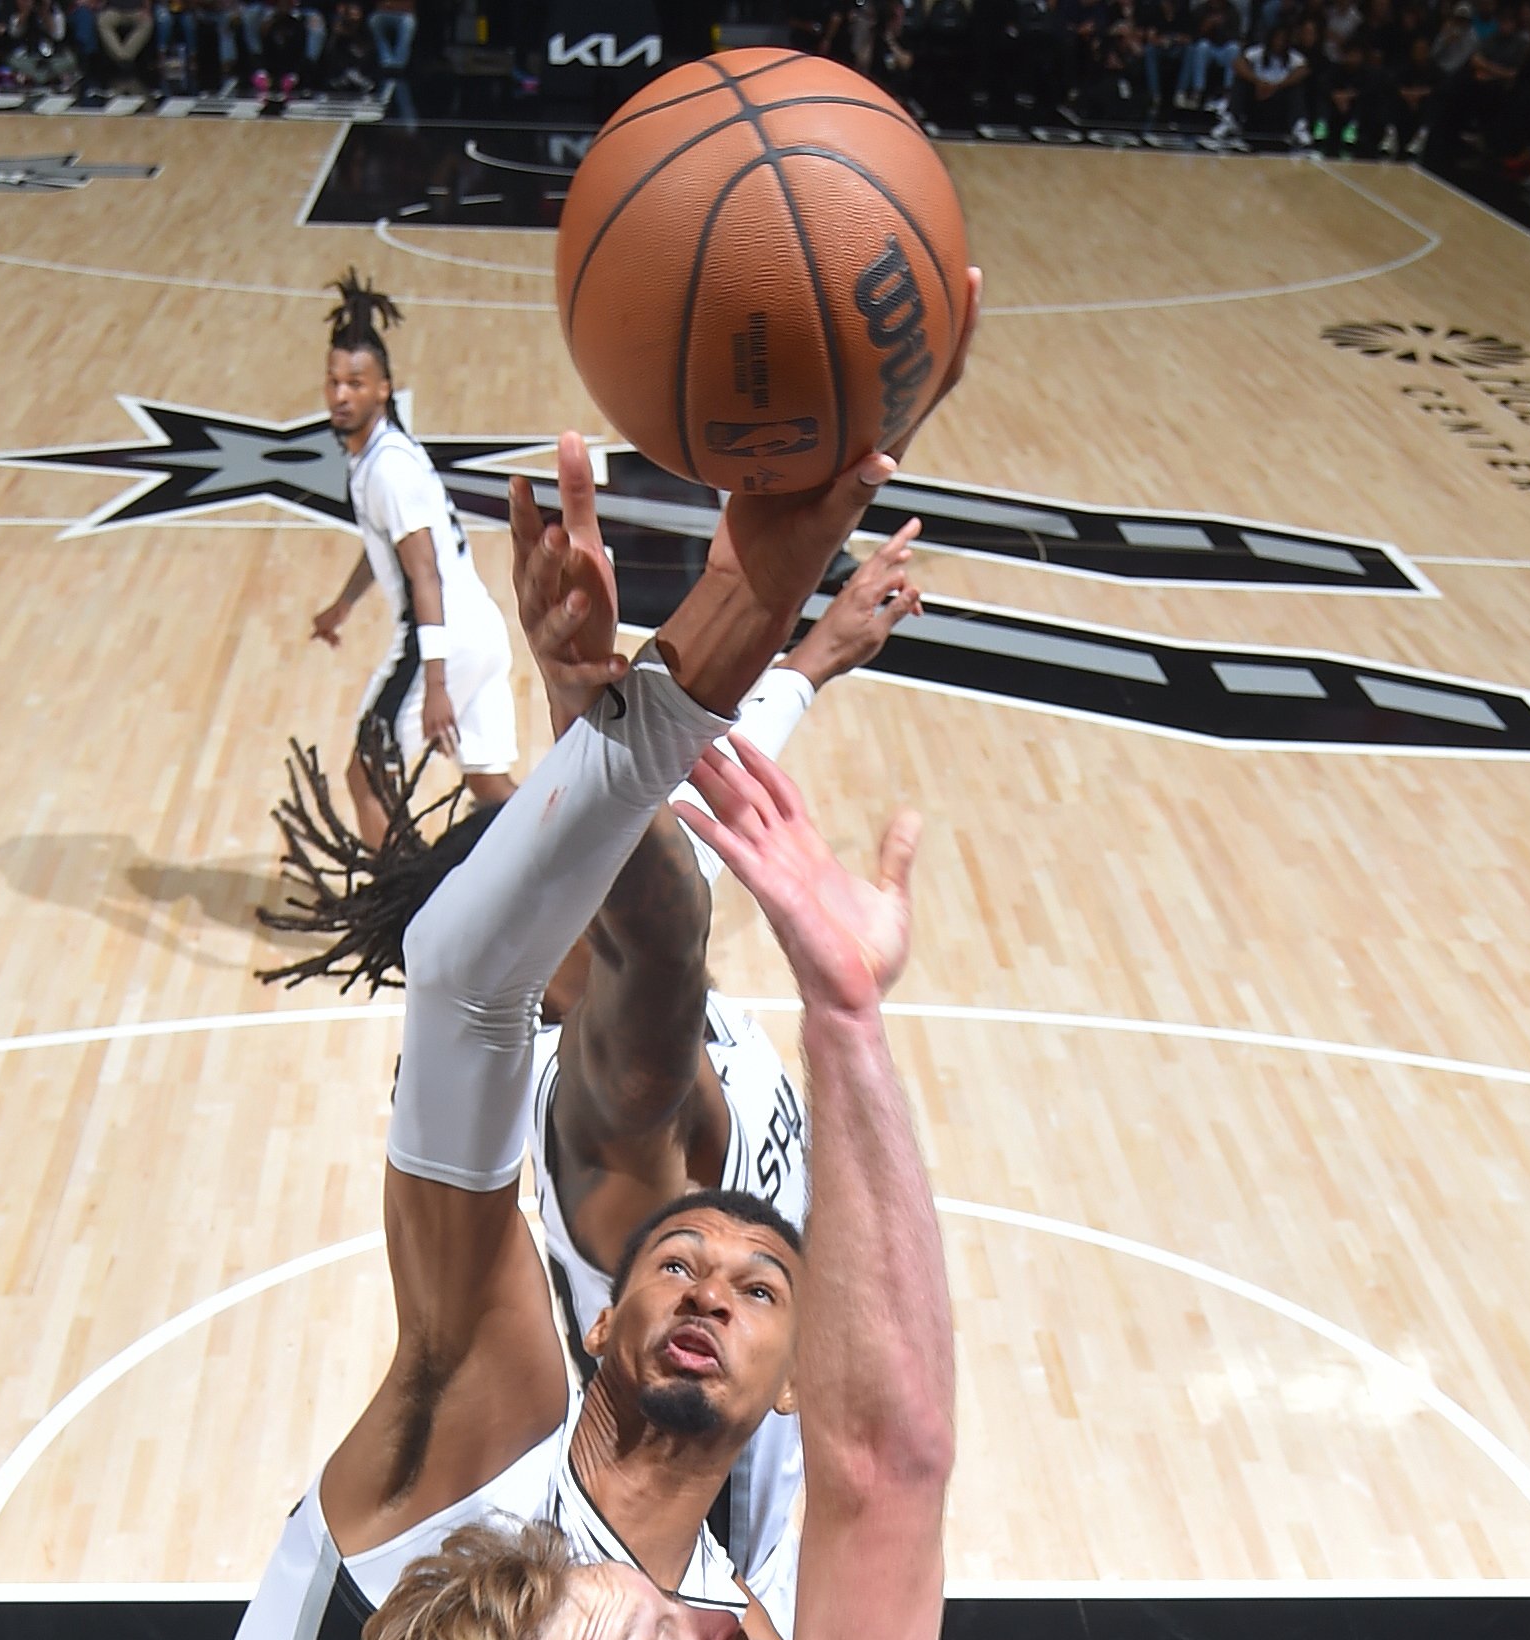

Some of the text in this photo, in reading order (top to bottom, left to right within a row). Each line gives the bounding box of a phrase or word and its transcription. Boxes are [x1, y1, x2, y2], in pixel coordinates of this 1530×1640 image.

[548, 32, 663, 67] KIA
[856, 233, 933, 450] Wils
[756, 1073, 803, 1206] SPU
